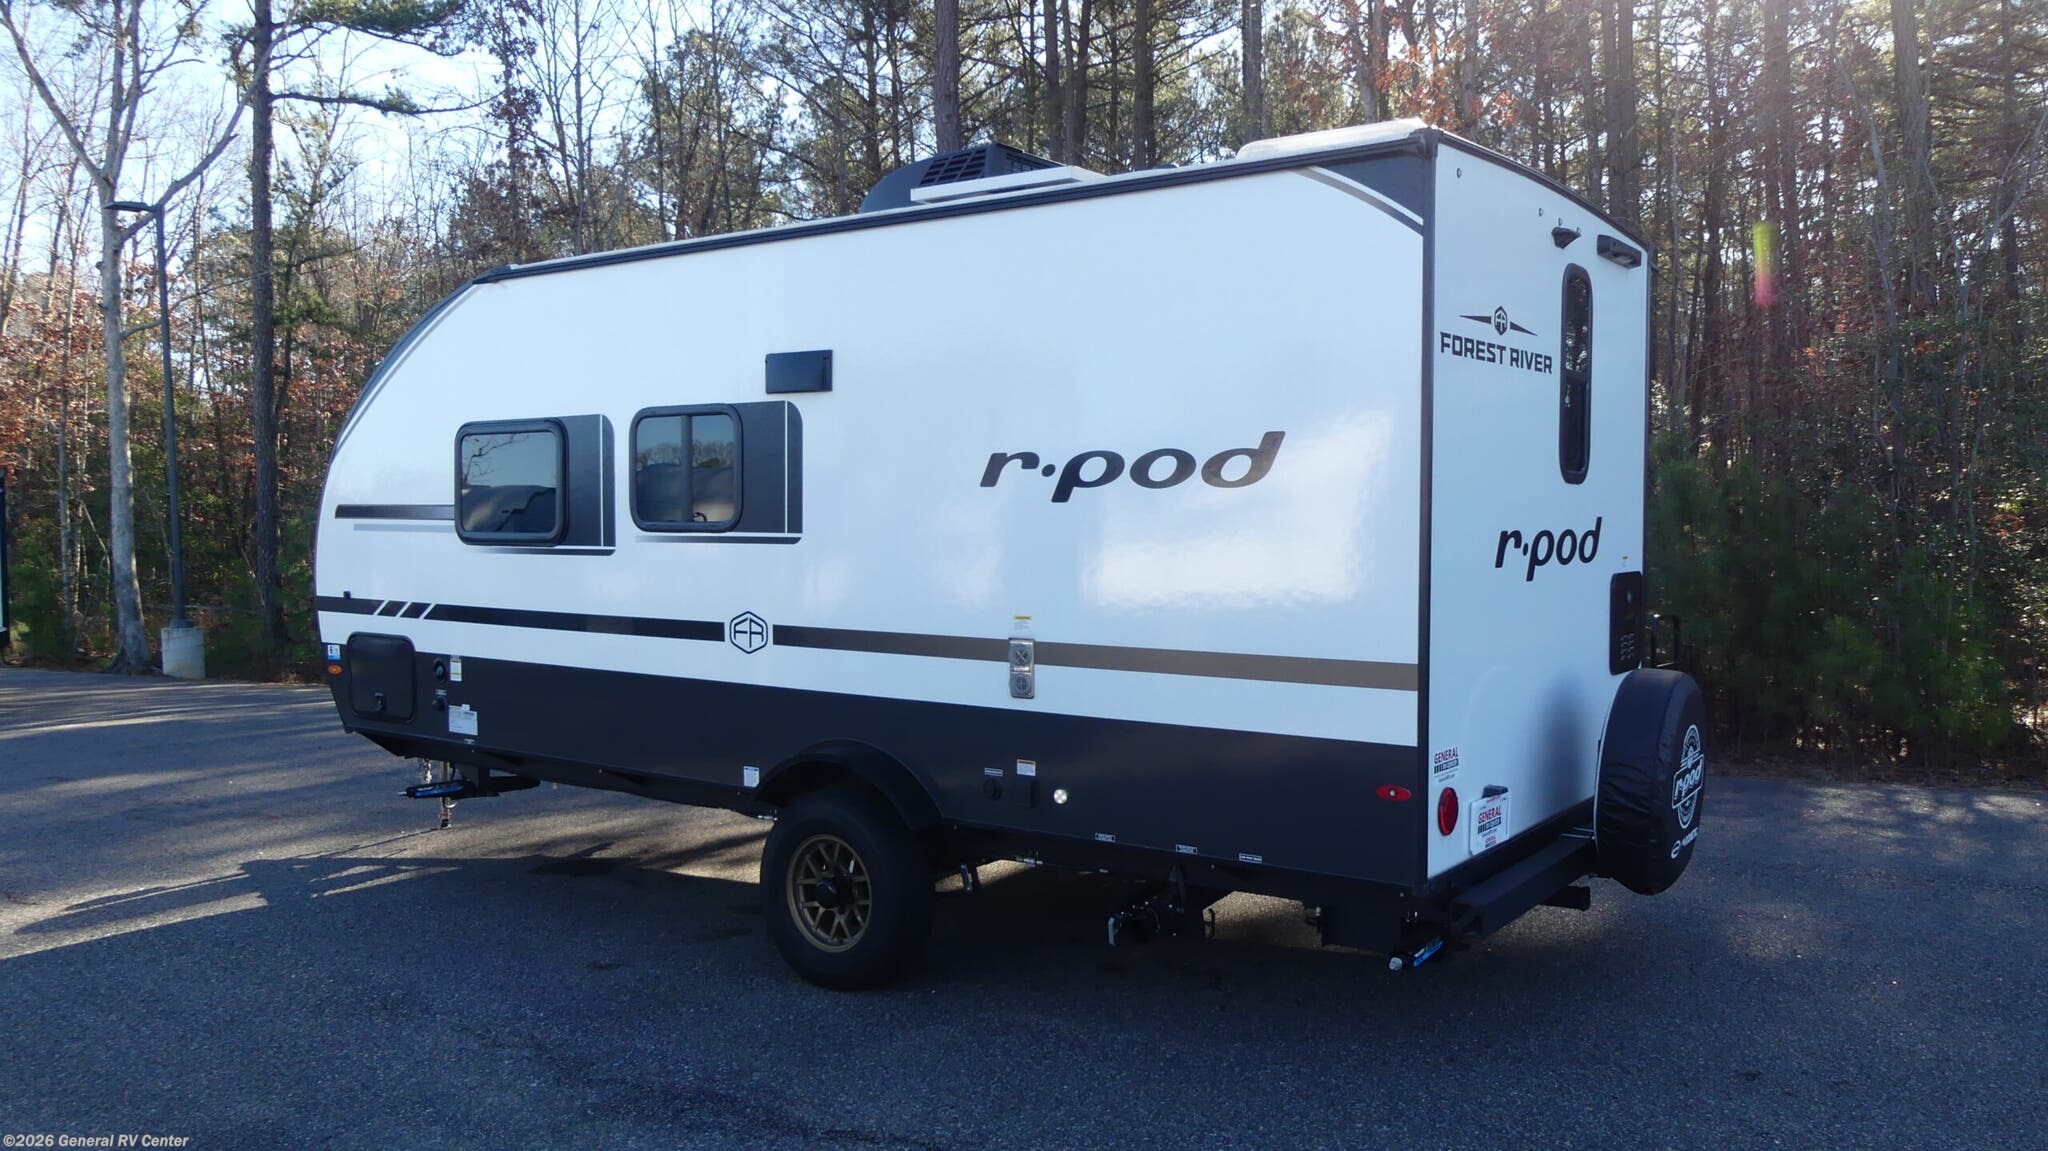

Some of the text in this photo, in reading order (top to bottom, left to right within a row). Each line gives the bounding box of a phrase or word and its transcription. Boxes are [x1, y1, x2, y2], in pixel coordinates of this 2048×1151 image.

[1440, 332, 1552, 374] FOREST RIVER
[1434, 747, 1459, 764] GENERAL
[1478, 805, 1502, 825] GENERAL
